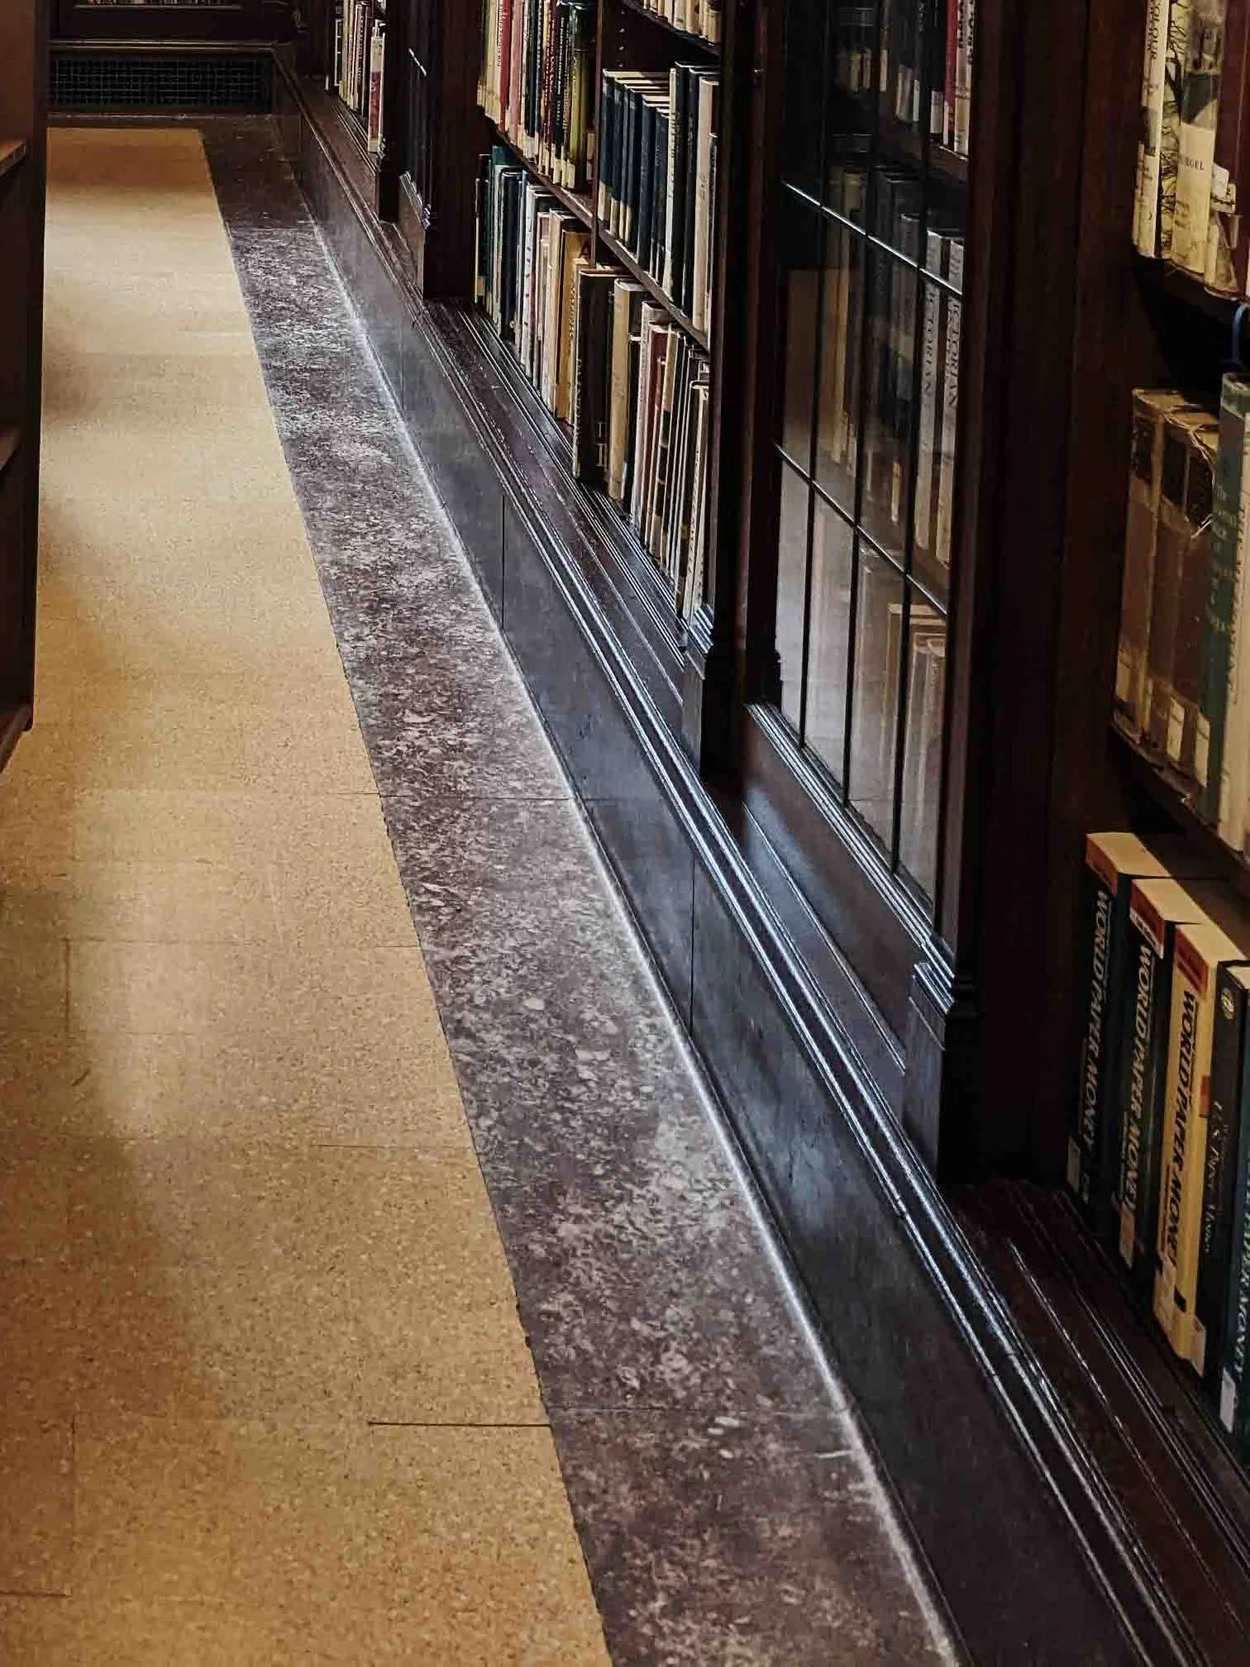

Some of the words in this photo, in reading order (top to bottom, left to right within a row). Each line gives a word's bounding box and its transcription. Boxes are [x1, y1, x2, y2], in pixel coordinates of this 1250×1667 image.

[1093, 889, 1110, 980] WORLD
[1087, 980, 1104, 1054] PAPER
[1135, 945, 1154, 1036] WORLD
[1129, 1036, 1147, 1120] PAPER
[1177, 990, 1196, 1085] WORLD
[1082, 1055, 1100, 1153] MONEY
[1172, 1086, 1189, 1171] PAPER
